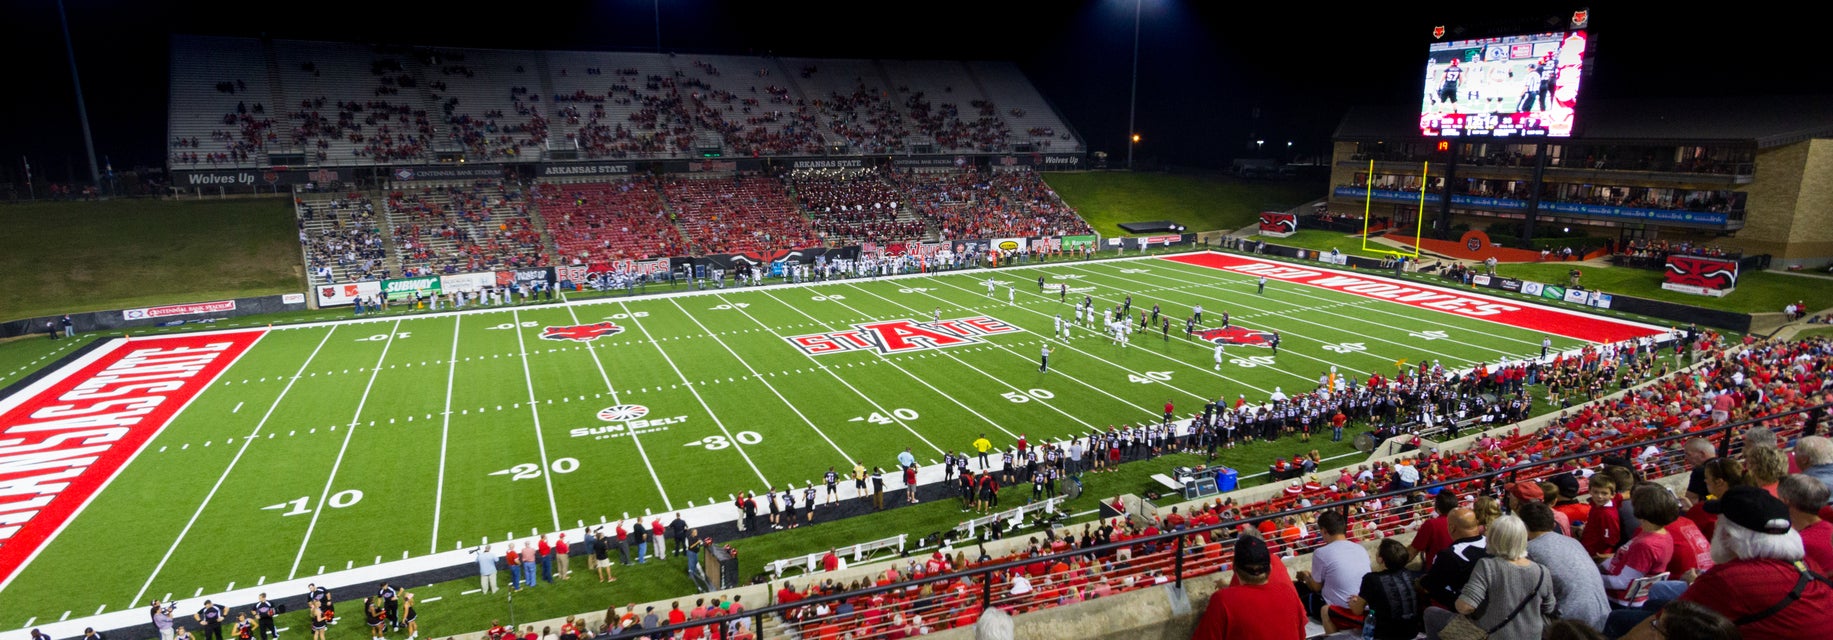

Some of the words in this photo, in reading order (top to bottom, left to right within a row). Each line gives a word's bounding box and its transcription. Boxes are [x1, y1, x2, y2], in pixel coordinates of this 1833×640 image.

[1438, 141, 1448, 150] 19
[794, 160, 836, 168] ARKANSAS
[837, 159, 862, 167] STATE
[1045, 156, 1069, 164] Wolves
[1069, 156, 1079, 165] Up
[545, 166, 597, 175] ARKANSAS
[598, 165, 628, 173] STATE
[189, 173, 235, 185] Wolves
[238, 172, 255, 185] Up
[387, 277, 437, 292] SUBWAY
[1225, 263, 1322, 279] RED
[1307, 274, 1521, 316] WOLVES
[149, 306, 187, 316] CENTENNIAL
[785, 316, 1023, 354] STATE
[57, 341, 234, 401] STATE
[1128, 371, 1172, 384] 40
[1001, 388, 1055, 404] 50
[867, 408, 919, 425] 40
[570, 424, 624, 437] SUN
[630, 415, 688, 429] BELT
[702, 430, 763, 450] 30
[510, 457, 580, 481] 20
[282, 489, 364, 517] 10
[1604, 528, 1610, 538] 1
